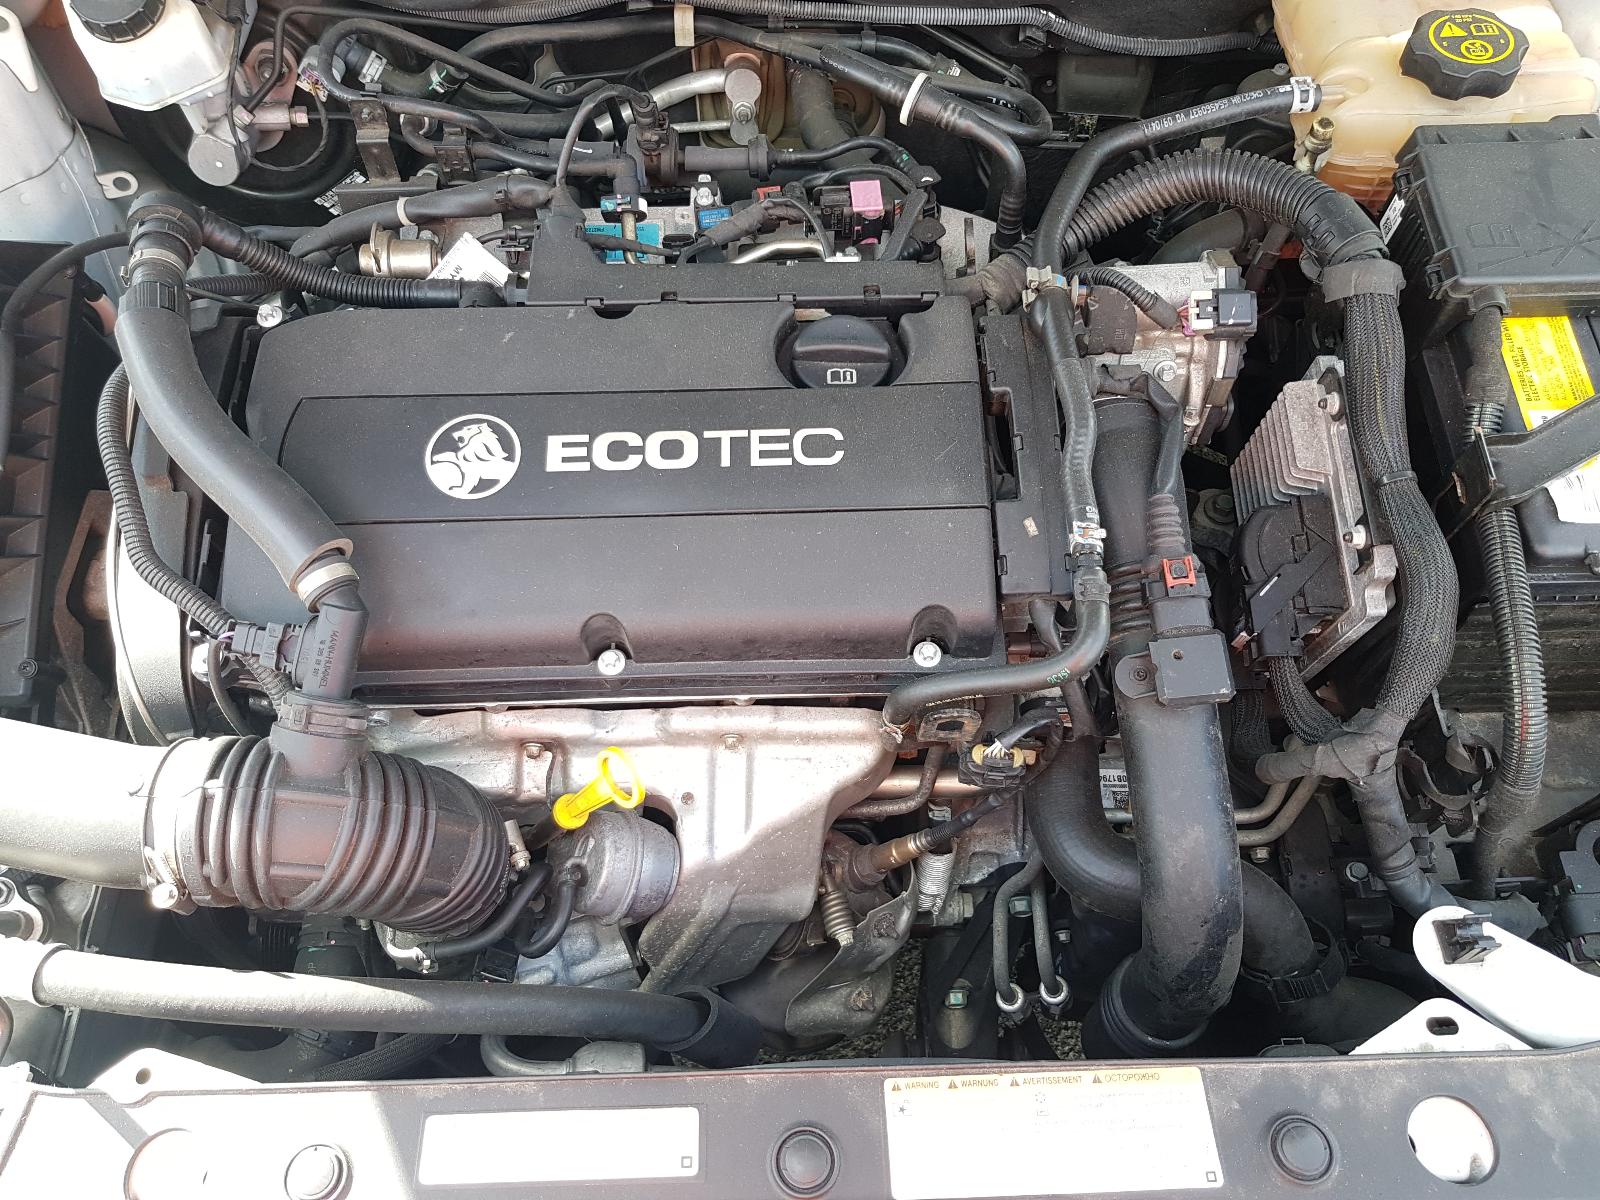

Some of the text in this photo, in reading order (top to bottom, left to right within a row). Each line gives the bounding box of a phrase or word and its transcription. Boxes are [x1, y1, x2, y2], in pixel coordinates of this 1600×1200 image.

[545, 427, 845, 473] ECOTEC
[904, 1075, 1083, 1090] WARNING WARNUNG AVERTISSEMENT
